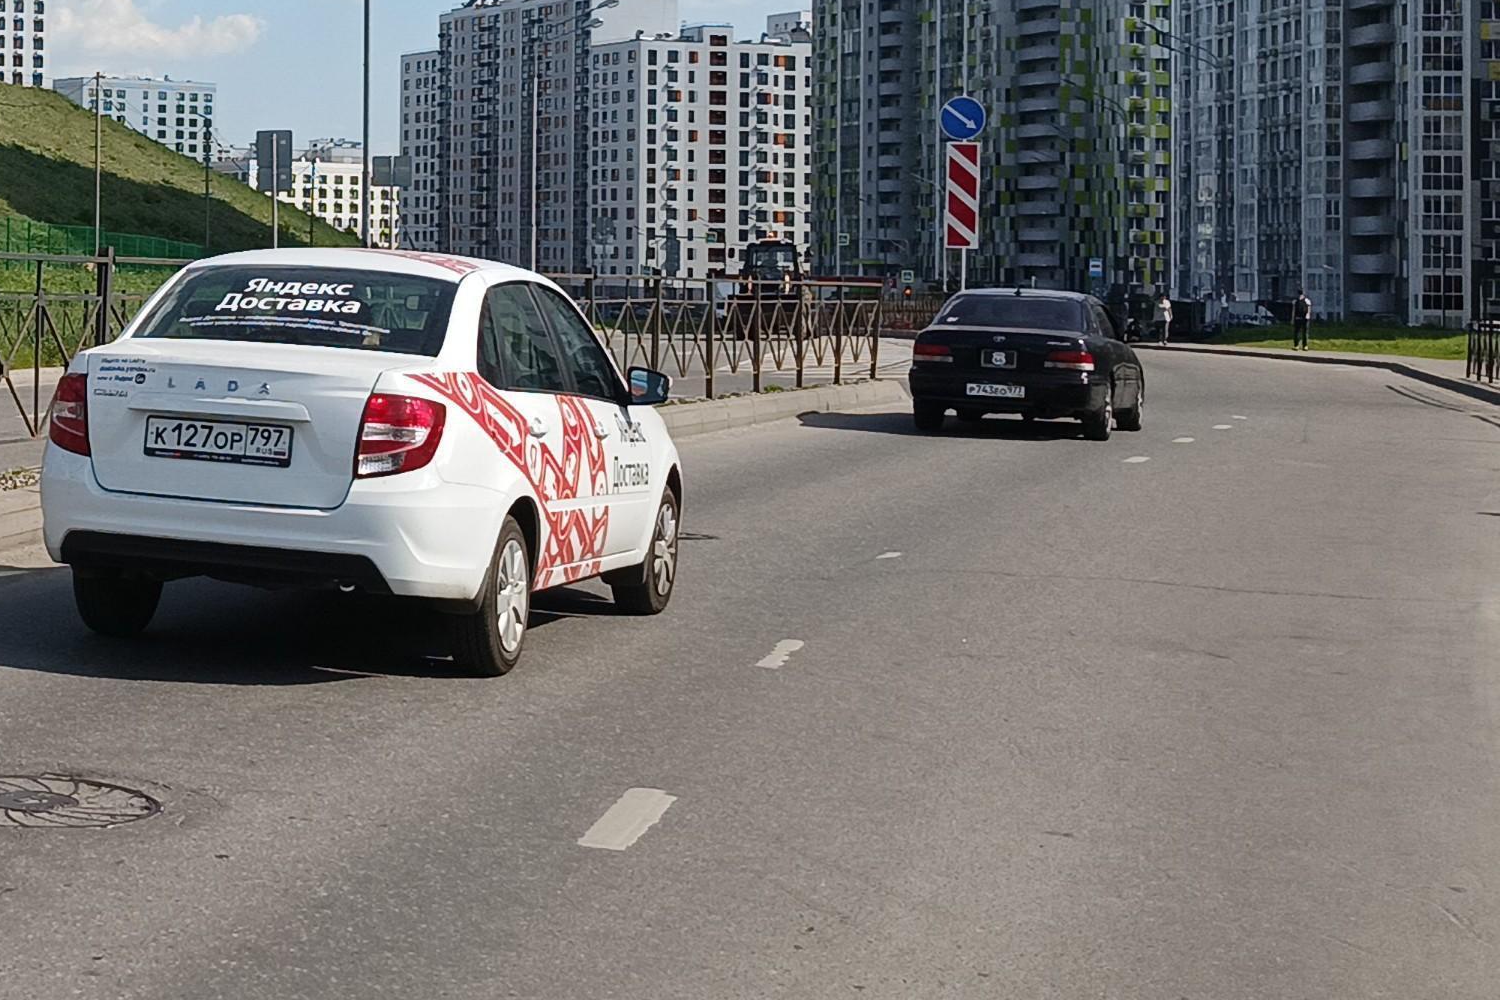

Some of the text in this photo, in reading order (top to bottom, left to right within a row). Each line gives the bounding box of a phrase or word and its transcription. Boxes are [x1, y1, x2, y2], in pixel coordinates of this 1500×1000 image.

[243, 278, 354, 296] Яндекс
[215, 293, 361, 314] Доставка
[167, 377, 270, 395] LADA
[249, 427, 284, 447] 797
